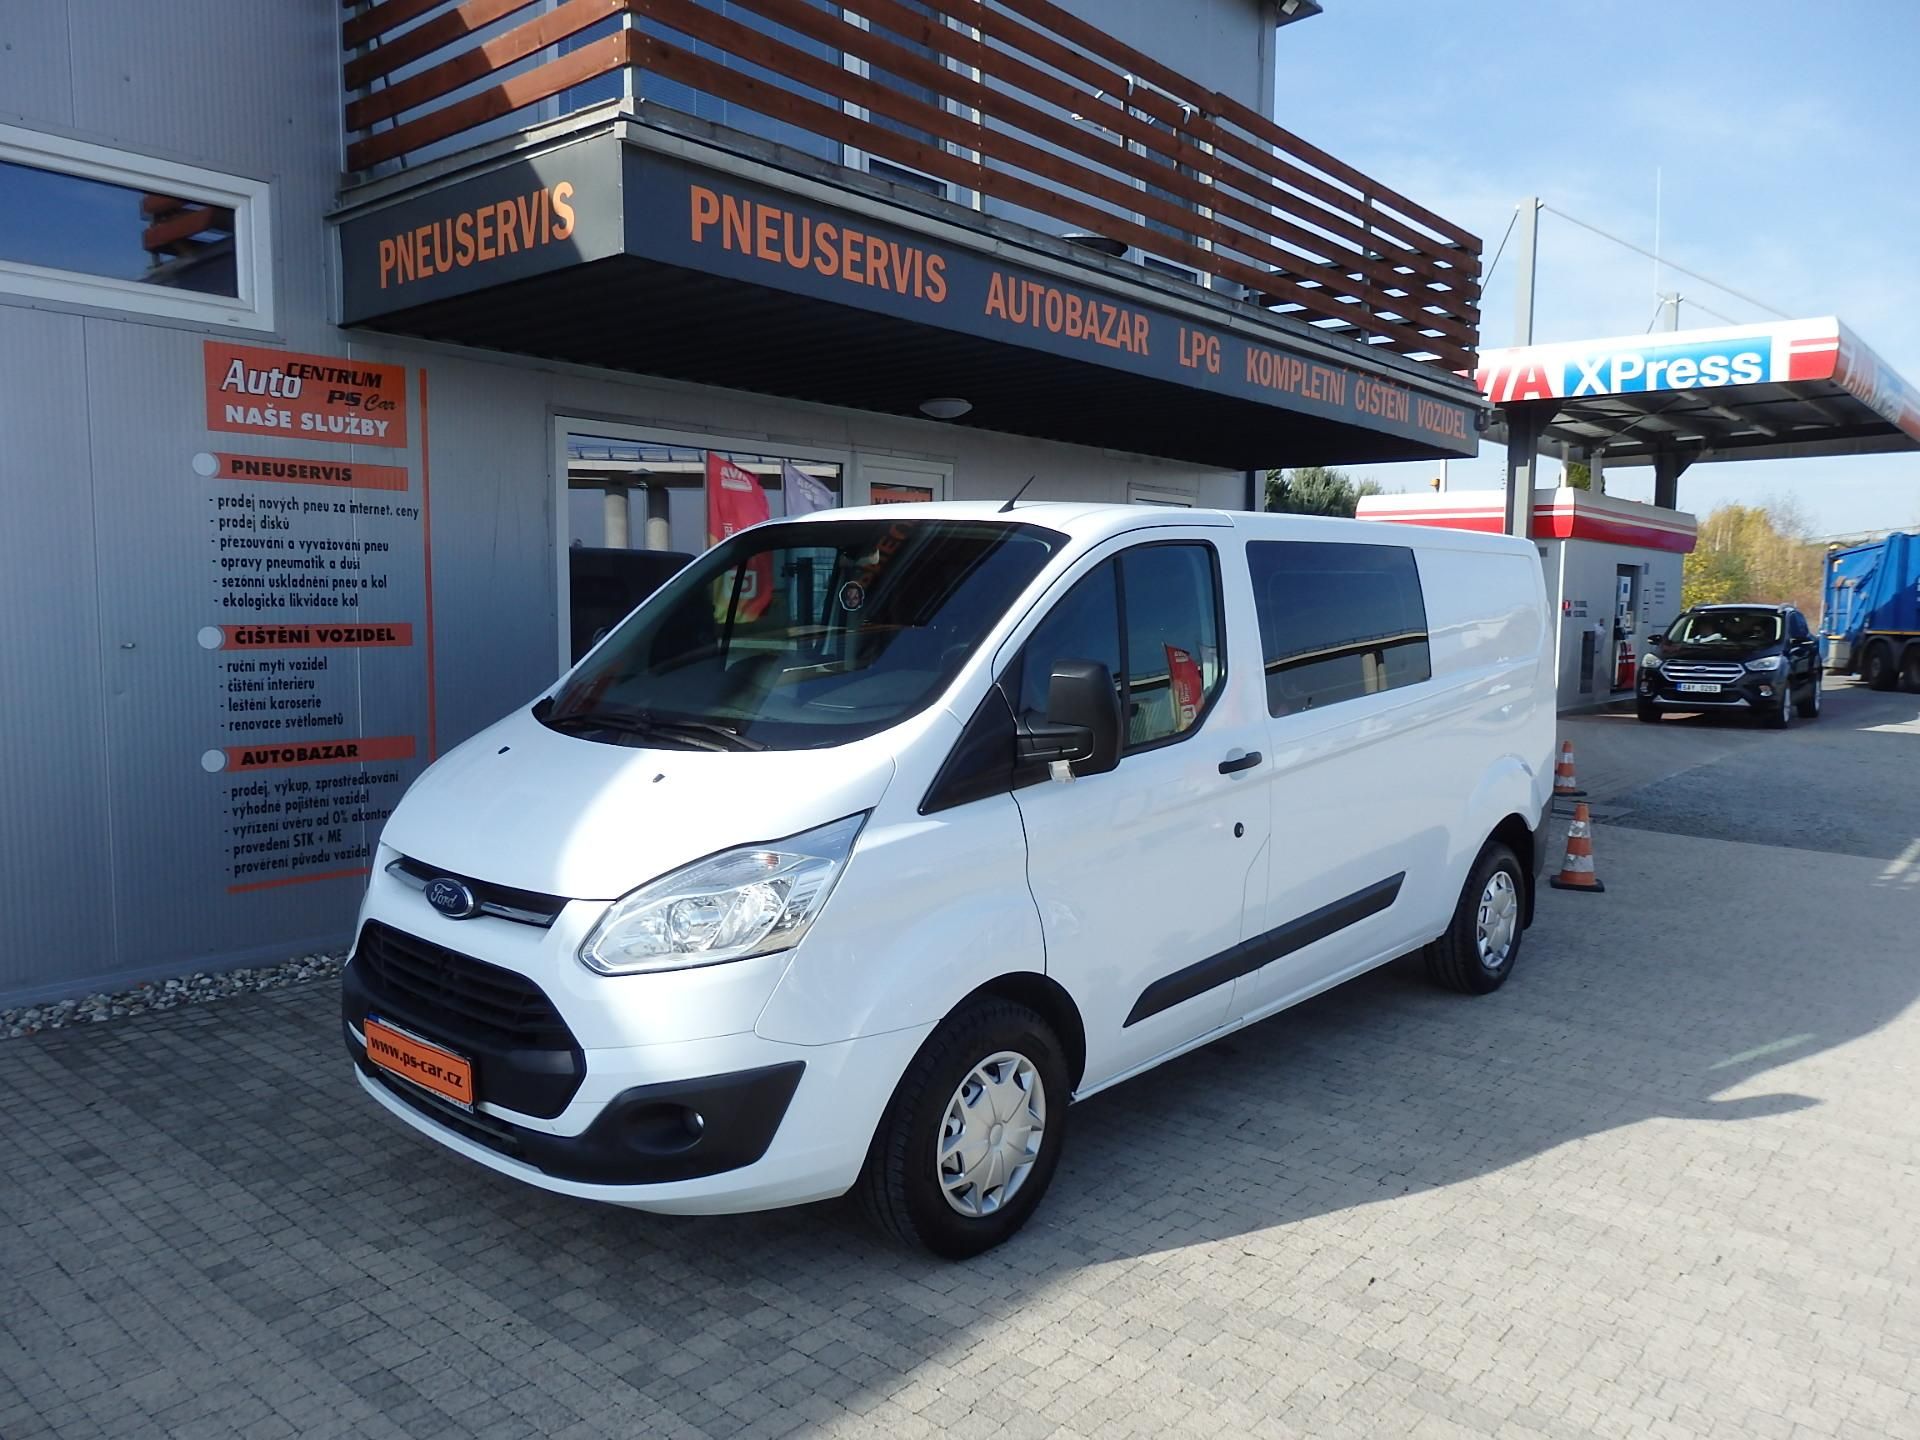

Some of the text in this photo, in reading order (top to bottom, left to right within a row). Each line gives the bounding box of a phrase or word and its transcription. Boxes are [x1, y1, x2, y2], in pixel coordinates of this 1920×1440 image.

[379, 181, 575, 289] PNEUSERVIS
[690, 184, 1467, 439] PNEUSERVIS AUTOBAZAR LPG KOMPLETNÍ ČIŠTĚNÍ VOZIDEL
[220, 358, 302, 399] Auto
[287, 362, 382, 388] CENTRUM
[1572, 352, 1762, 397] XPress
[327, 390, 397, 412] PS Car
[225, 402, 389, 437] NAŠE SLUŽBY
[231, 460, 353, 482] PNEUSERVIS
[218, 493, 419, 520] prodej nových pneu za internet. ceny
[219, 514, 290, 533] prodej disků
[220, 535, 389, 555] přezouvání a vyvažování pneu
[221, 558, 262, 572] opravy
[266, 555, 325, 572] pneumatik
[329, 560, 336, 569] a
[222, 573, 387, 592] sezónní uskladnění pneu a kol
[223, 592, 359, 611] ekologická likvidace kol
[234, 625, 395, 645] ČIŠTĚNÍ VOZIDEL
[227, 659, 255, 673] ruční
[289, 656, 328, 671] vozidel
[228, 676, 315, 692] čištění interiéru
[228, 694, 322, 712] leštění karoserie
[229, 712, 344, 732] renovace světlometů
[240, 744, 358, 766] AUTOBAZAR
[315, 769, 399, 792] zprostředkování
[333, 789, 370, 806] vozidel
[317, 811, 329, 826] od
[333, 810, 349, 824] 0%
[352, 807, 393, 822] akontac
[233, 836, 290, 860] provedení
[293, 831, 315, 848] STK
[328, 828, 342, 843] ME
[234, 842, 371, 878] prověření původu vozidel
[431, 883, 458, 908] Ford
[371, 1037, 463, 1089] www.ps-car.cz
